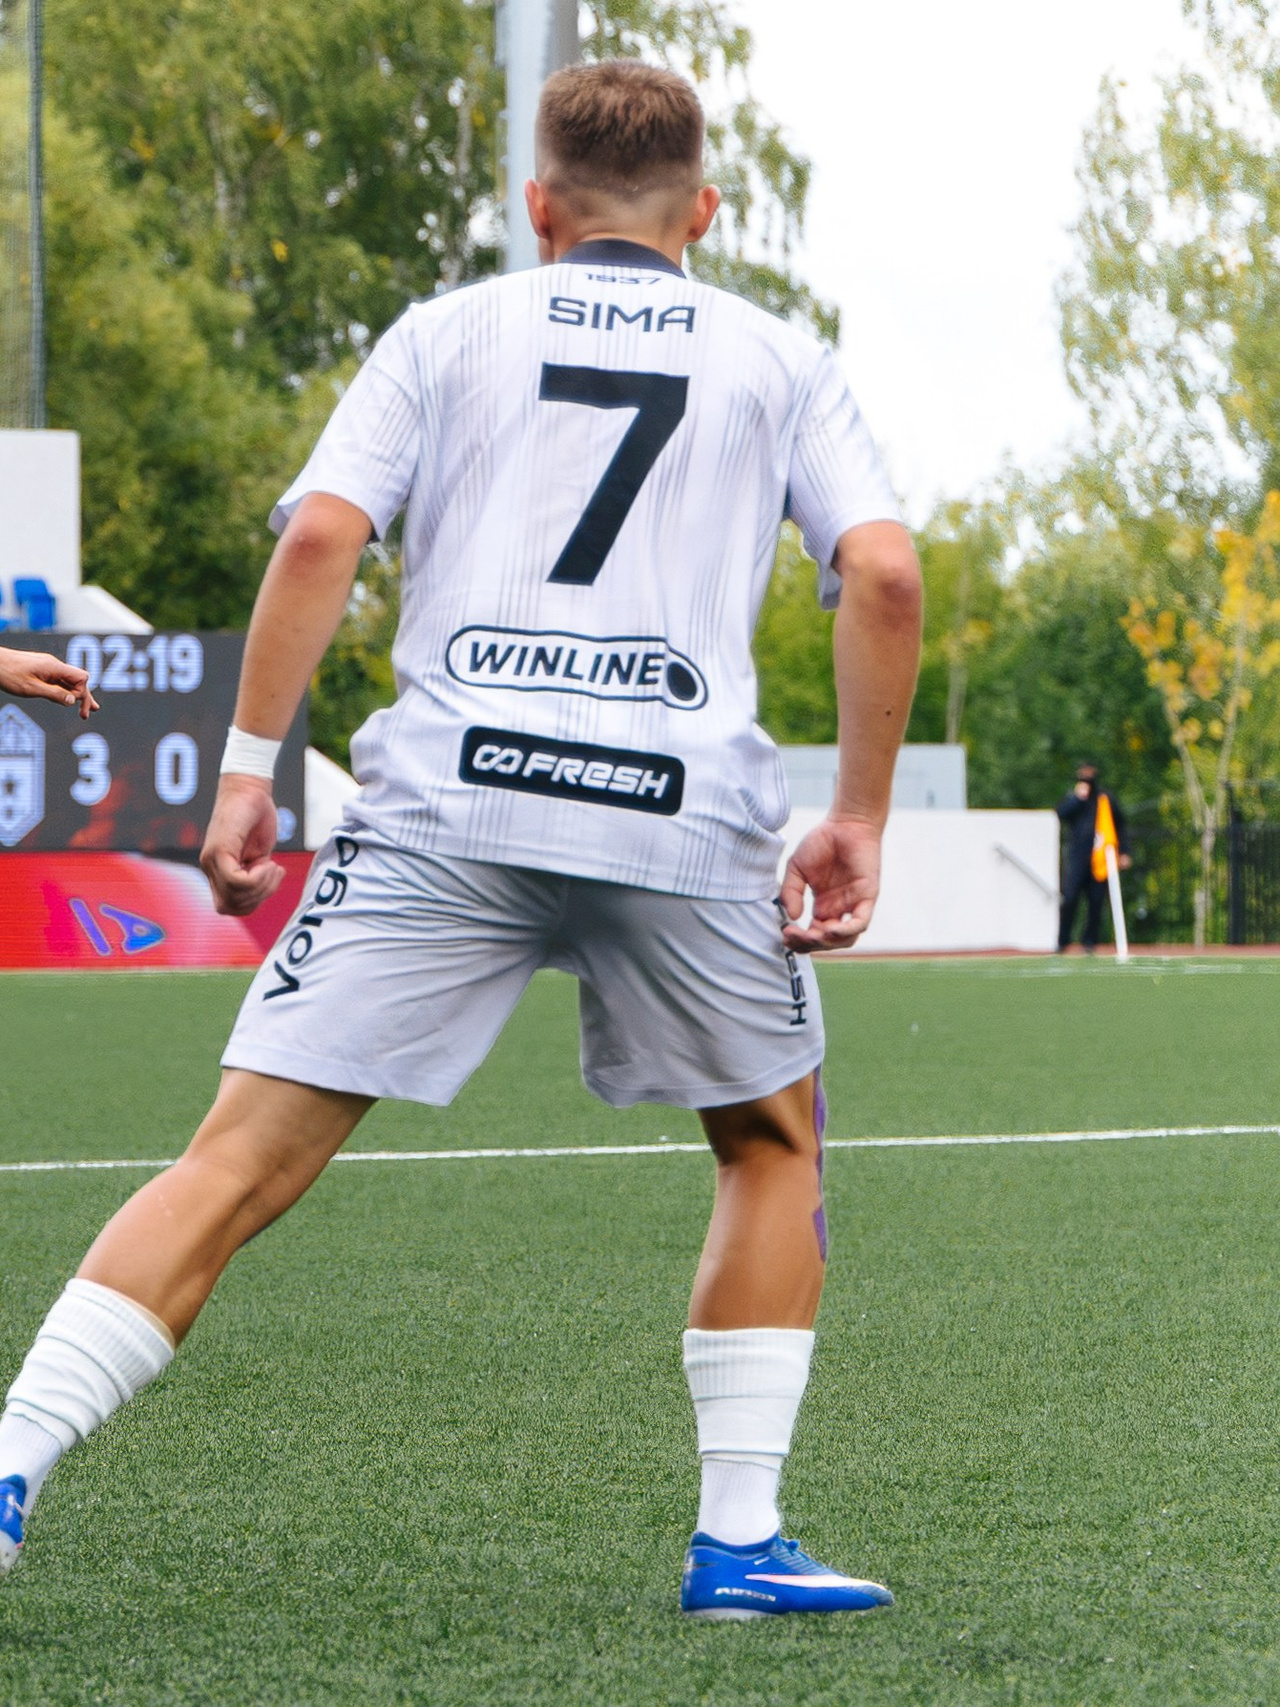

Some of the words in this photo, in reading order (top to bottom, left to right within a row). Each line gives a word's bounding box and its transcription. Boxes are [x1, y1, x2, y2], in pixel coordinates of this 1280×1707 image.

[548, 295, 697, 334] SIMA
[538, 361, 691, 586] 7
[66, 634, 204, 694] 02:19
[469, 641, 666, 686] WINLINE
[69, 732, 112, 806] 3
[154, 732, 199, 805] 0
